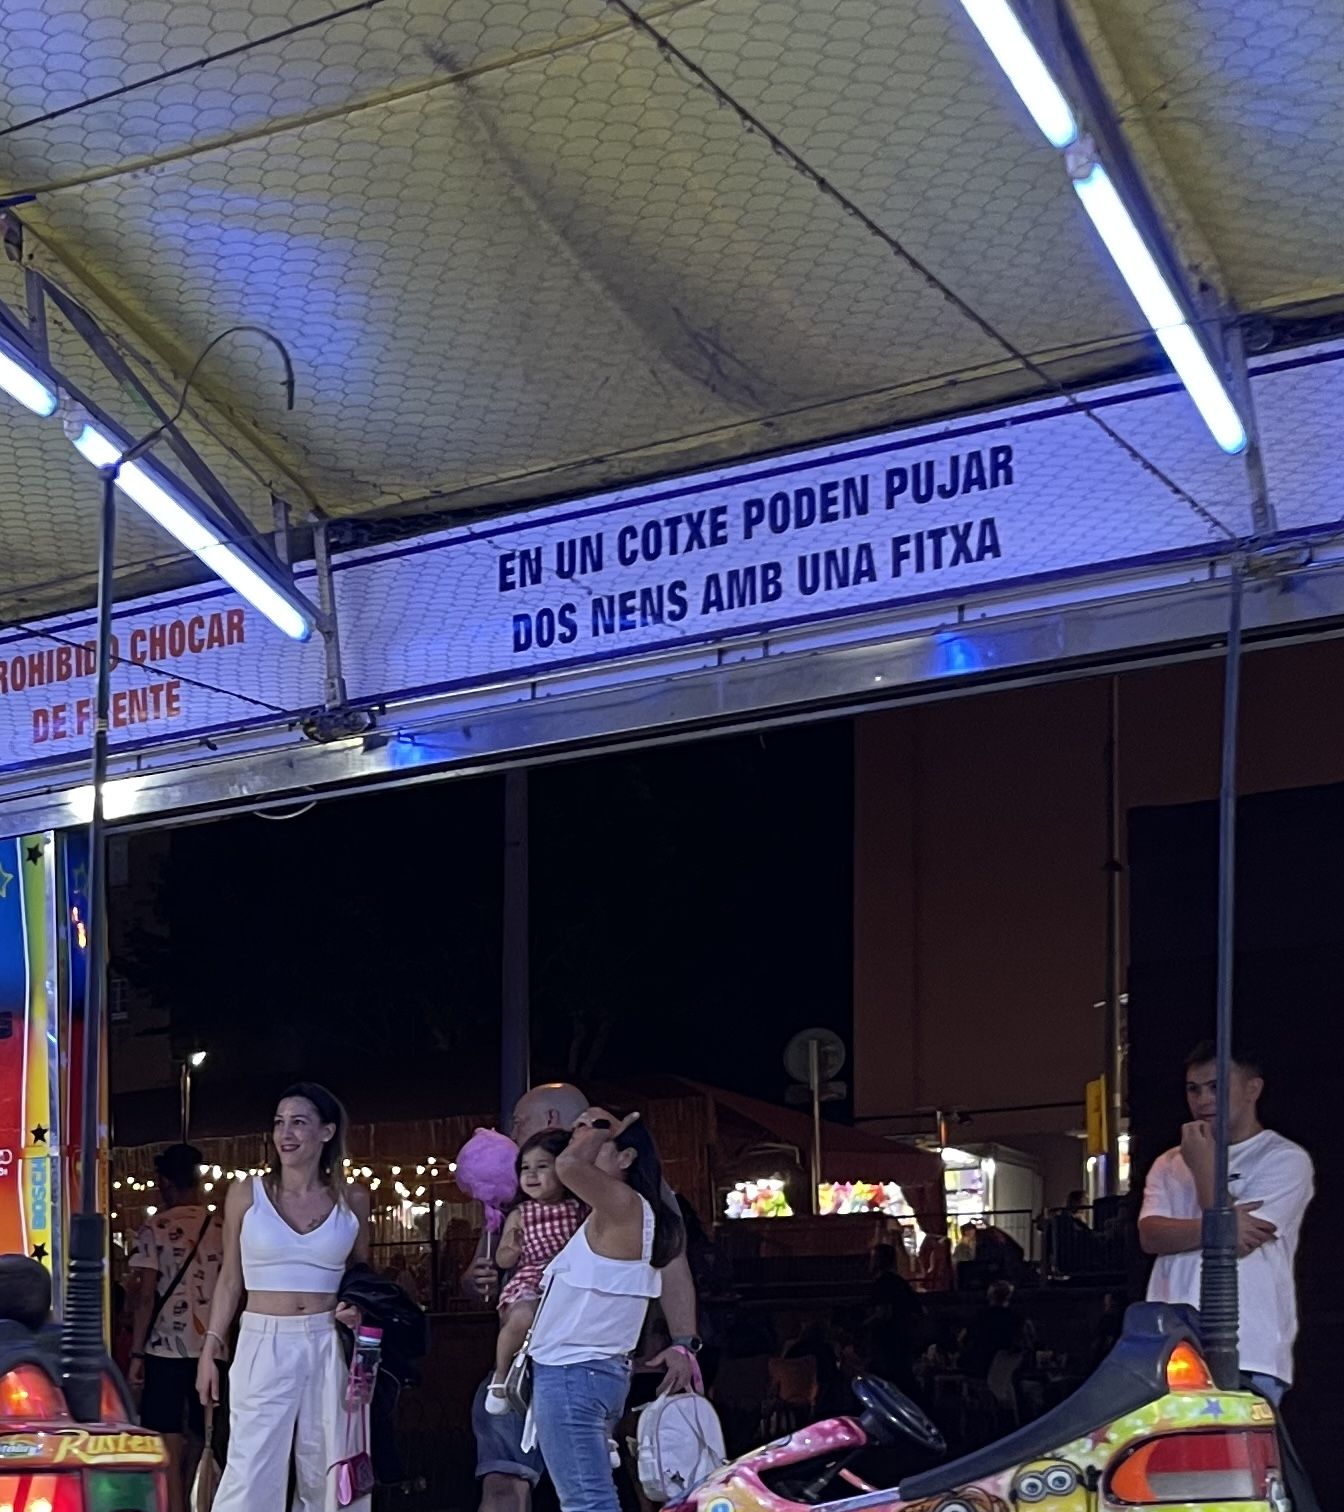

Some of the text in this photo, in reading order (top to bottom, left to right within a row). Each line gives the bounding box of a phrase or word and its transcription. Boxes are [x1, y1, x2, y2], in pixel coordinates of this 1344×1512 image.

[498, 444, 1014, 593] EN UN COTXE PODEN PUJAR
[512, 516, 1002, 653] DOS NENS AMB UNA FITXA
[130, 608, 245, 665] CHOCAR
[32, 681, 181, 744] DE FENTE
